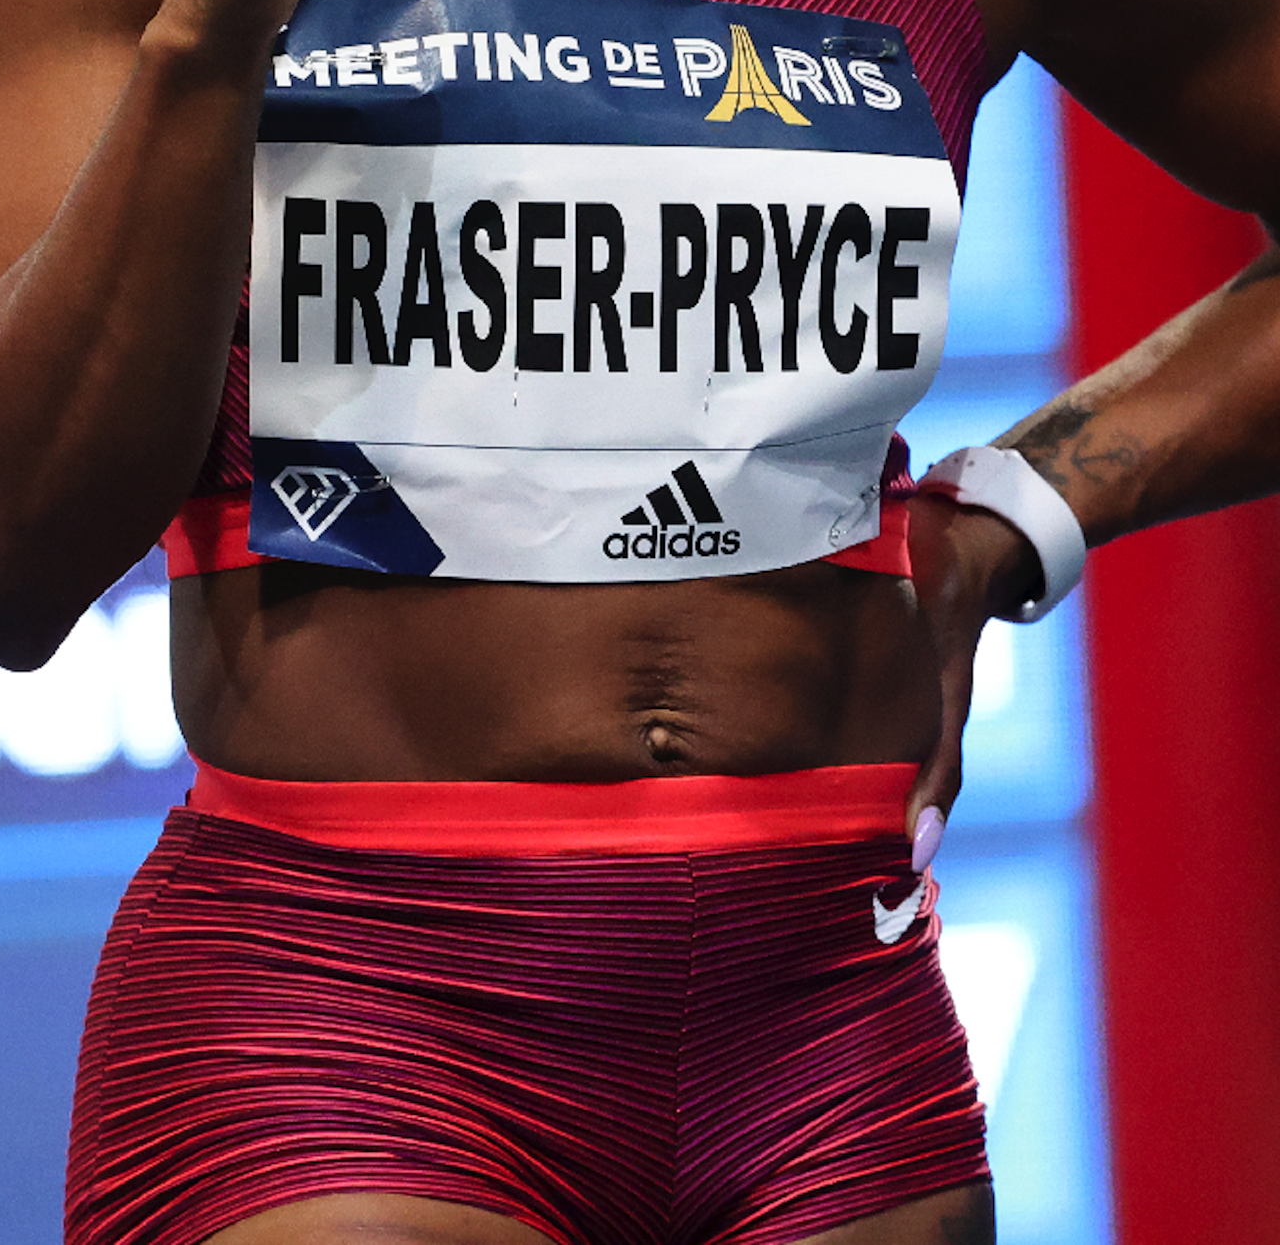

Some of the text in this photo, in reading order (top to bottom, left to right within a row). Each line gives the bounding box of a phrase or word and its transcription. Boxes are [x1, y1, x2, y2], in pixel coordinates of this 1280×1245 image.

[273, 23, 902, 126] MEETING DE PARIS
[279, 196, 930, 374] FRASER-PRYCE
[602, 525, 741, 560] adidas
